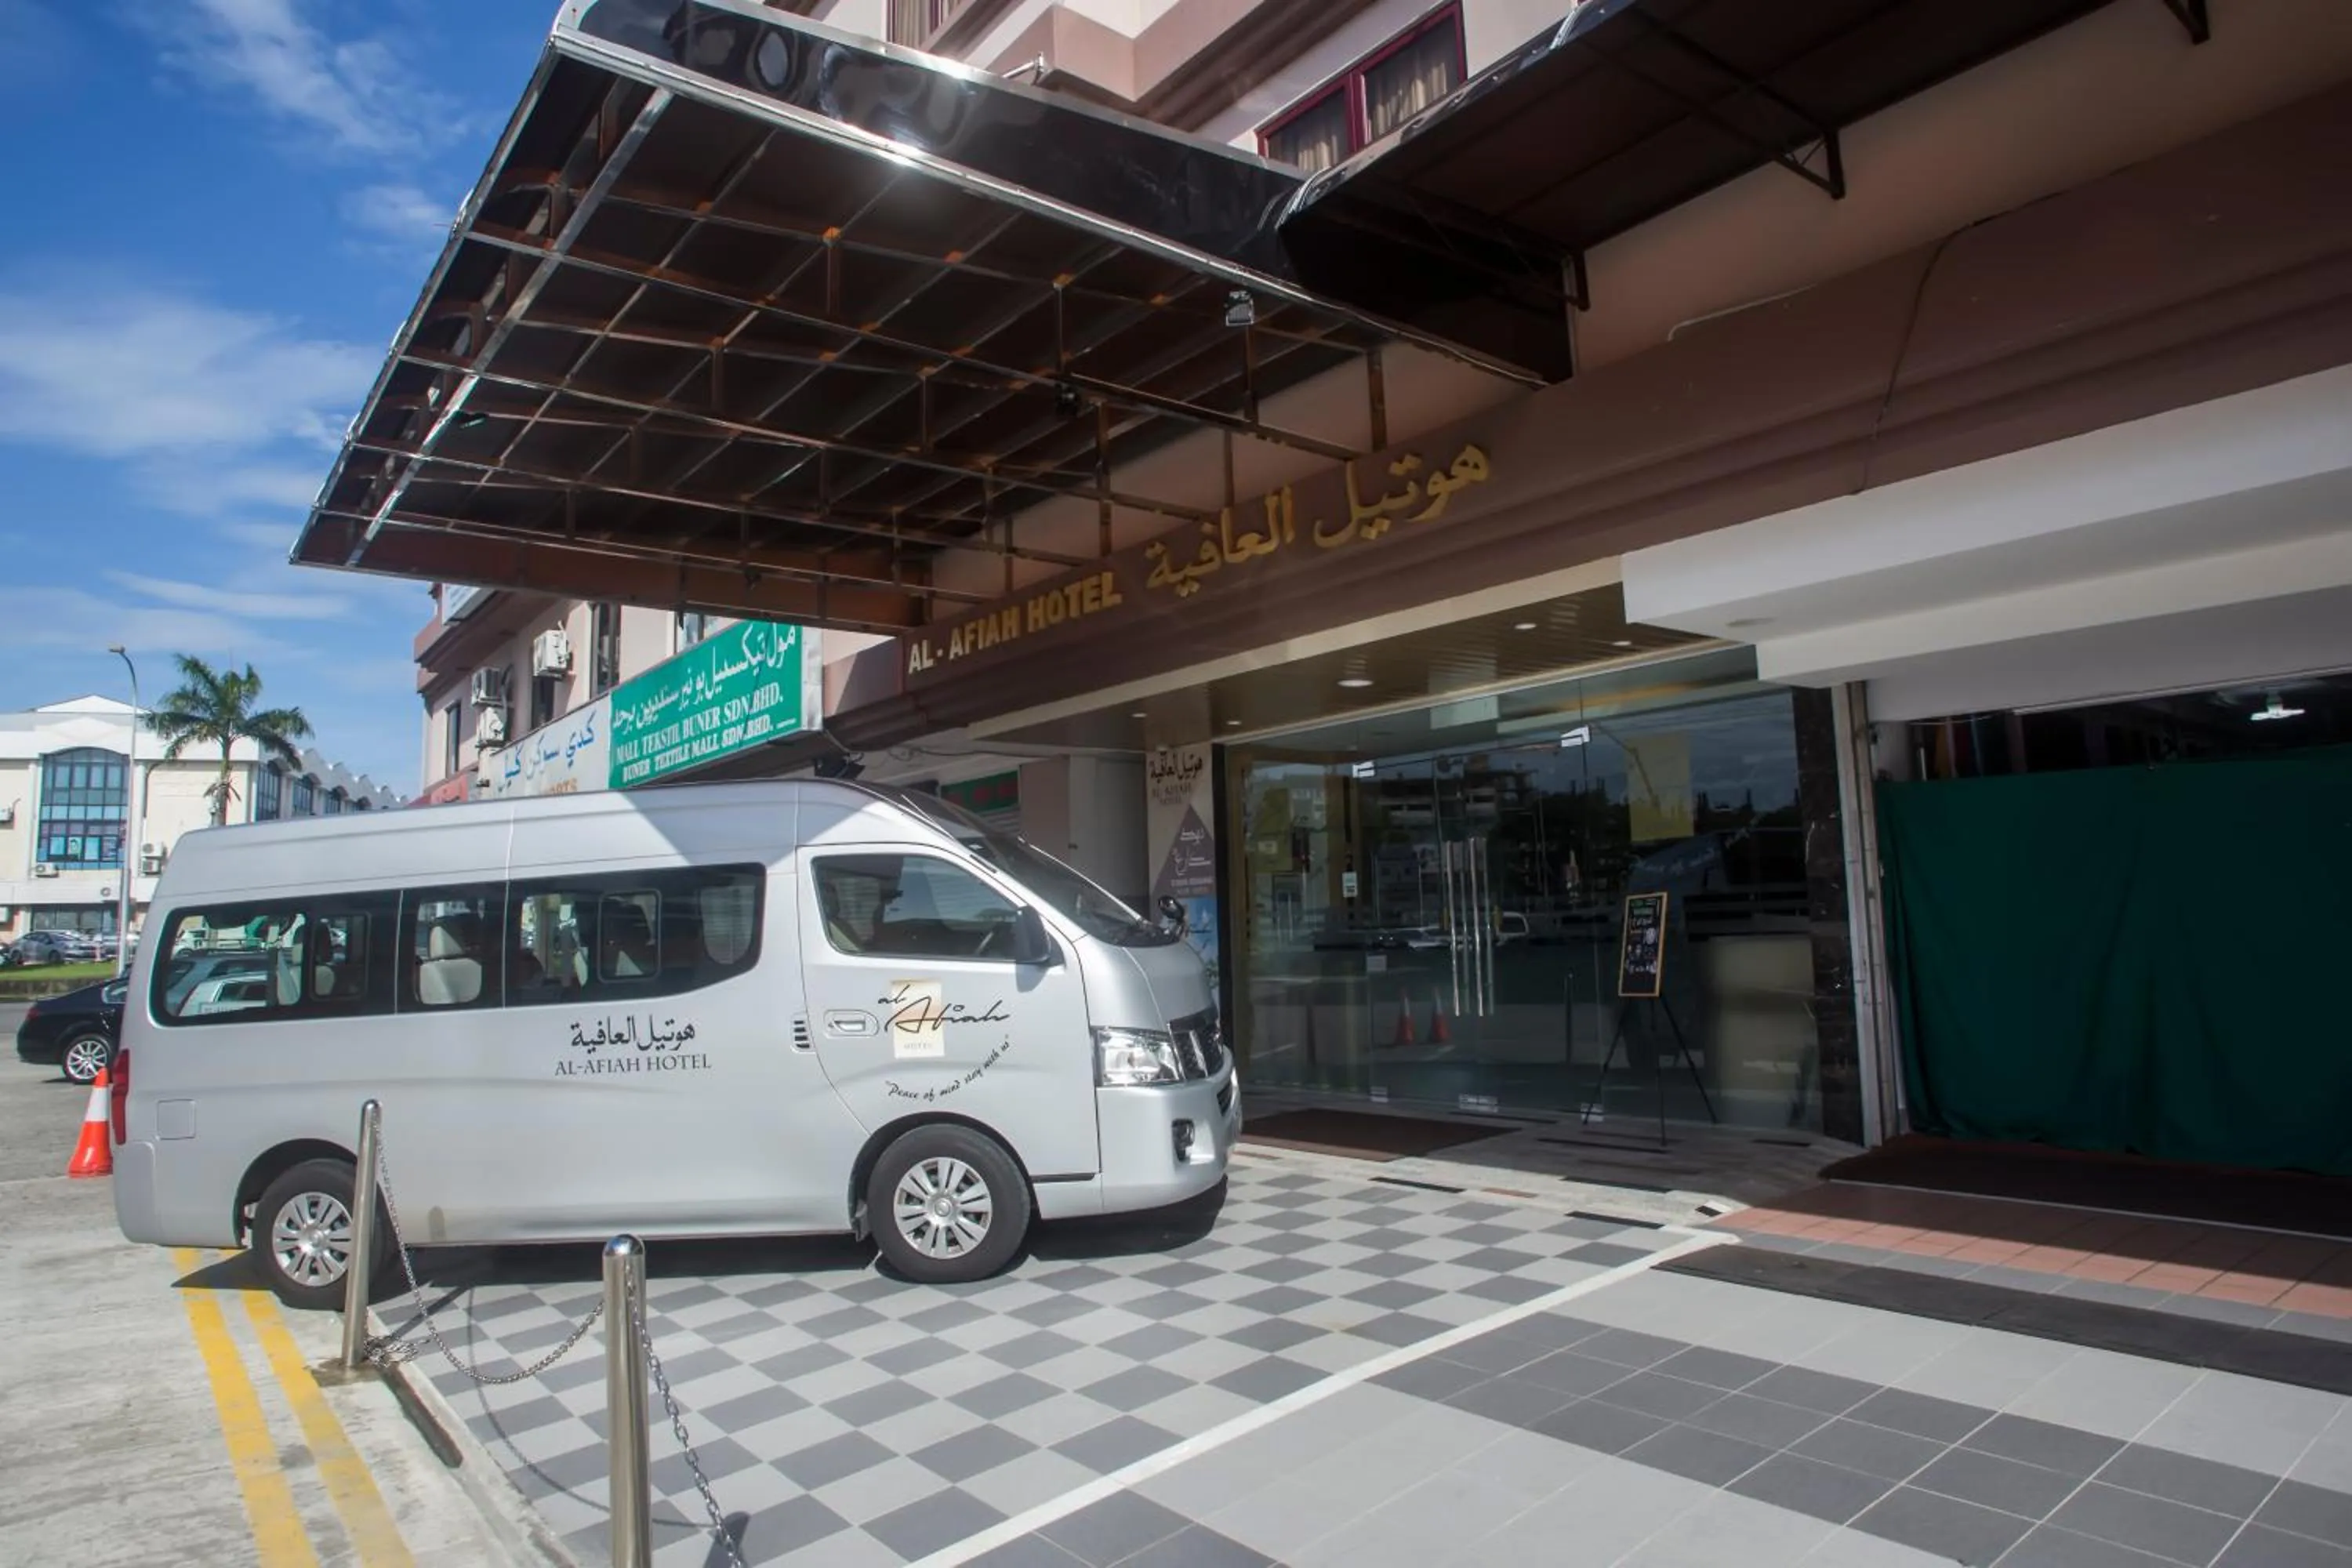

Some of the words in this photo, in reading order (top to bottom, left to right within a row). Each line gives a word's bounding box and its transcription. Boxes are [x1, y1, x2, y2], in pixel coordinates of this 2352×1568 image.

[1314, 444, 1488, 548] هوتيل
[1146, 484, 1295, 597] العافية
[1028, 572, 1123, 633] HOTEL
[683, 706, 720, 739] BUNER
[570, 1015, 637, 1054] العافية
[637, 1014, 695, 1051] هوتيل
[554, 1058, 641, 1076] AL-AFIAH
[647, 1053, 713, 1072] HOTEL
[923, 1088, 935, 1102] of
[939, 1079, 960, 1097] mind
[983, 1048, 1000, 1070] with
